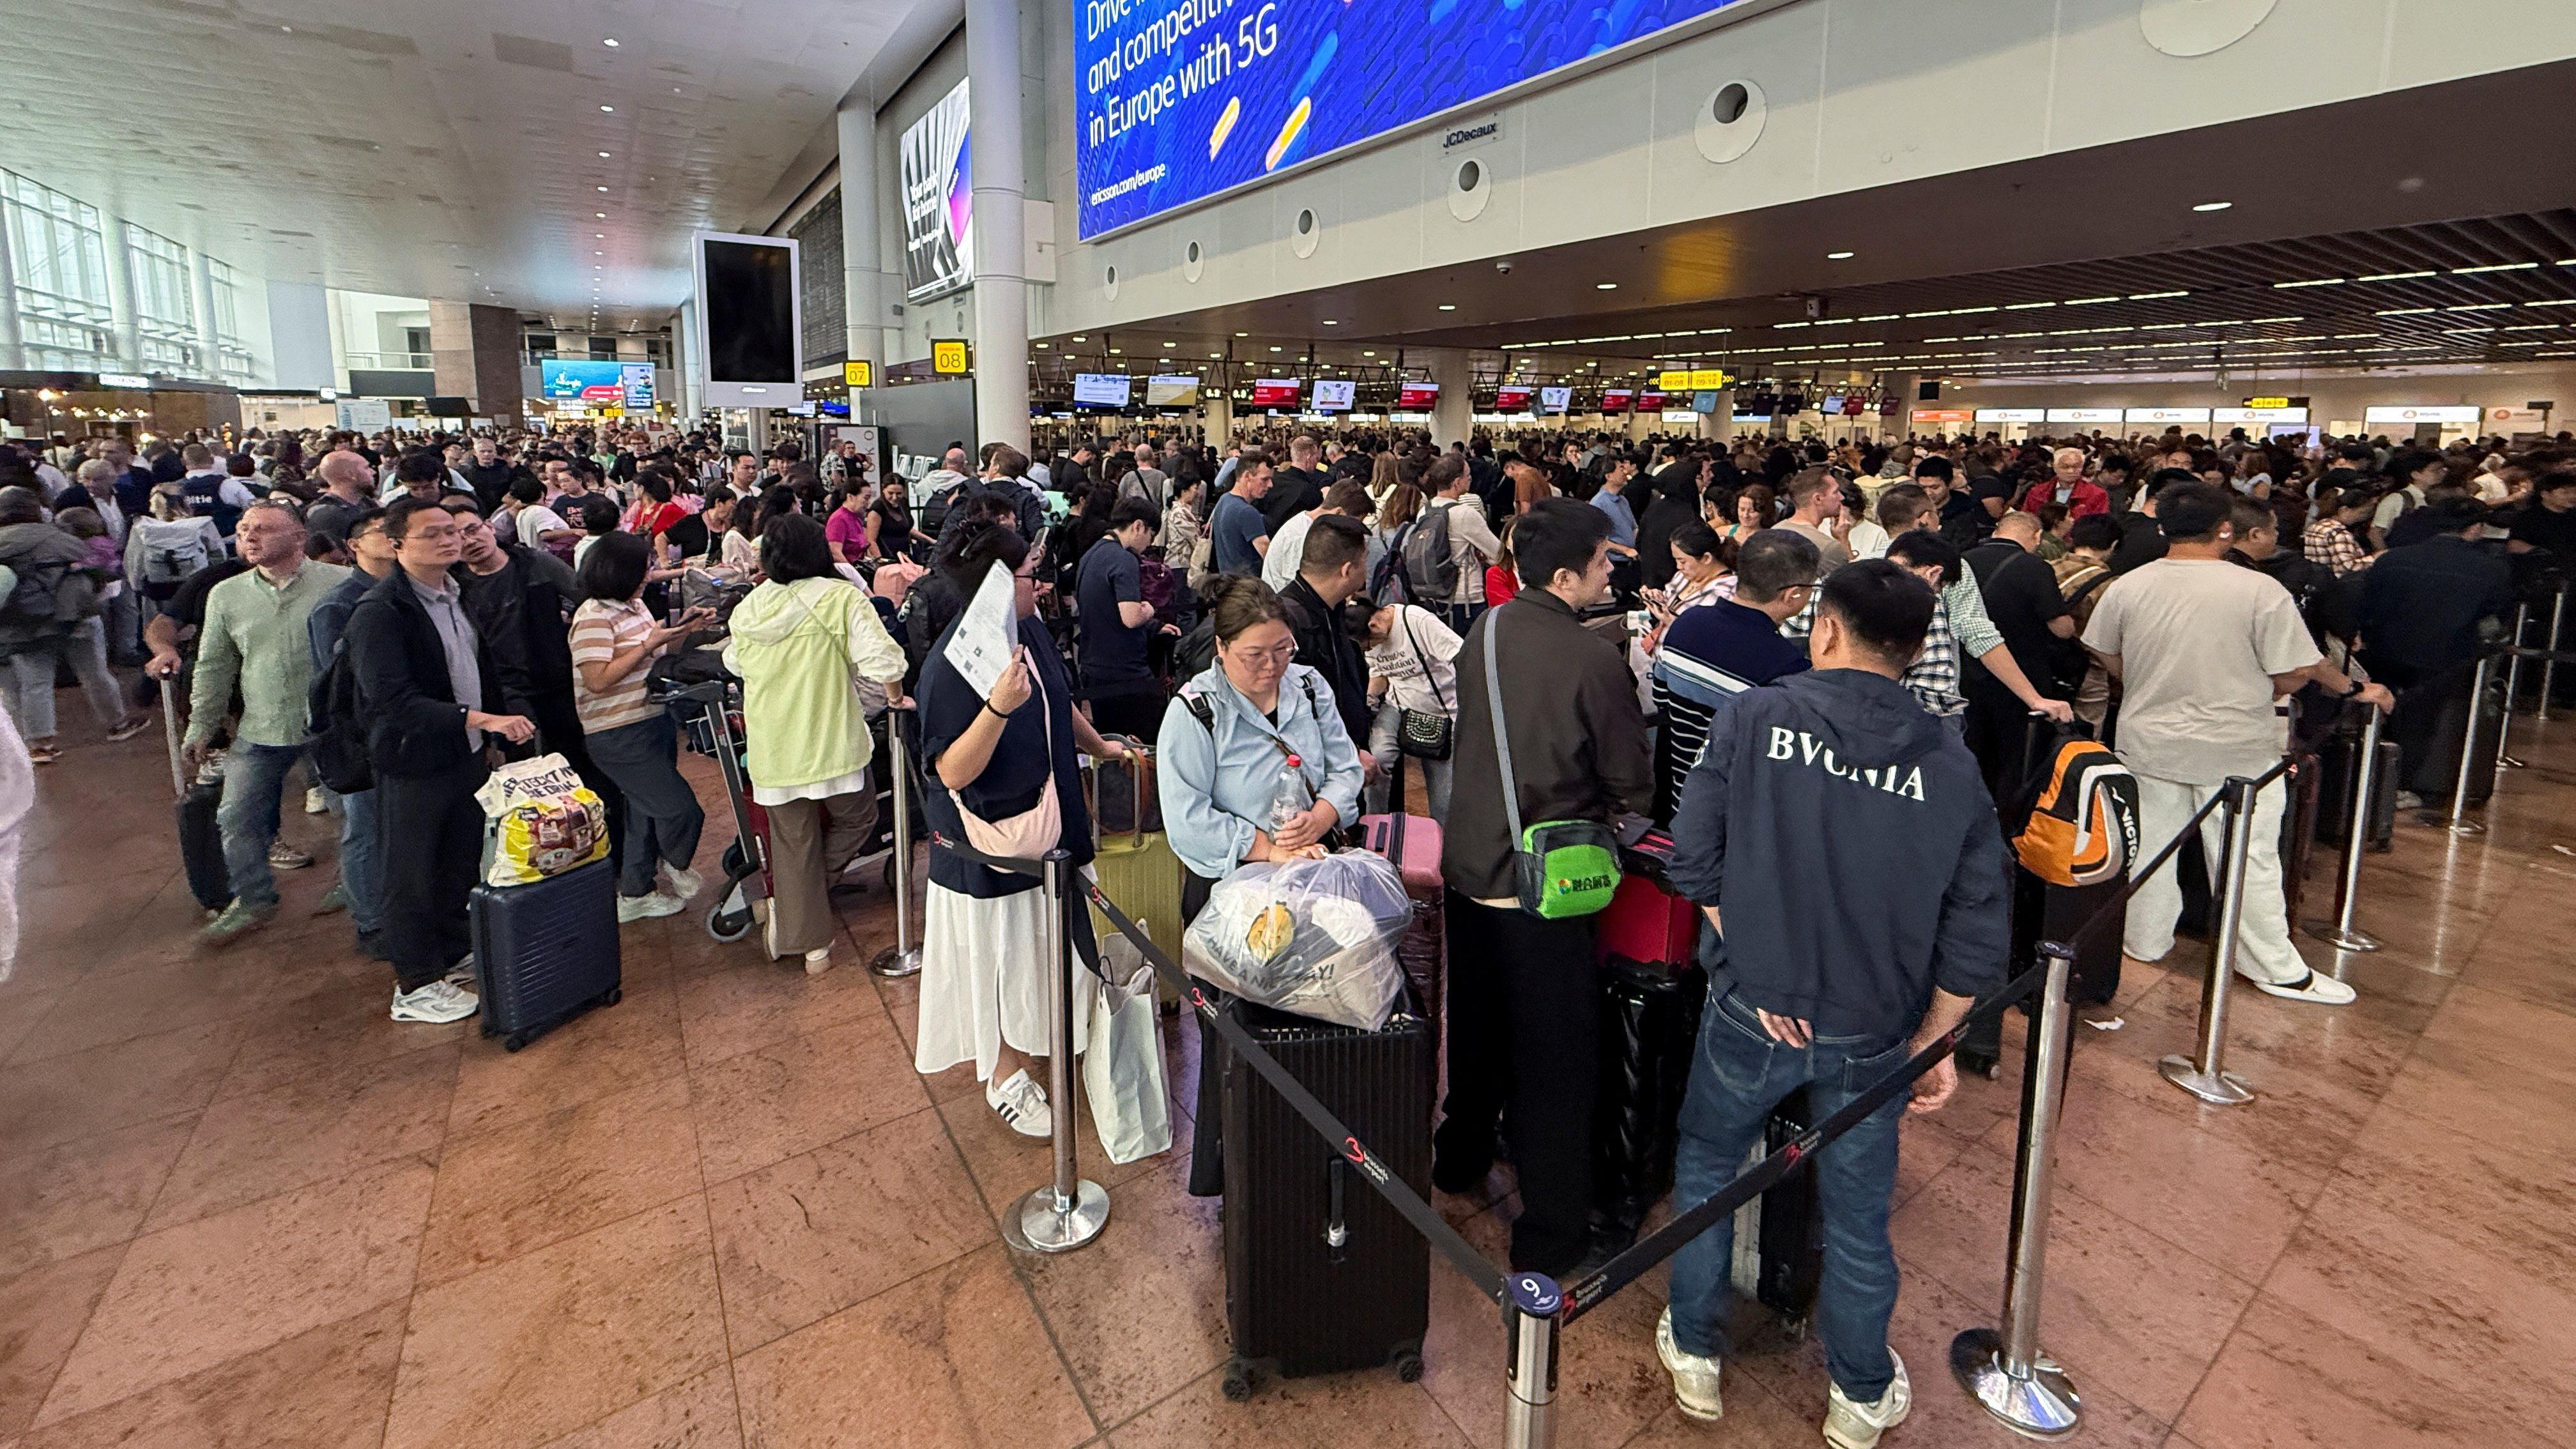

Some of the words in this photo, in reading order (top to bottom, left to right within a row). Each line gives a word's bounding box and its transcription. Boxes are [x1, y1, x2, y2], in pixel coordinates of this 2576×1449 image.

[1088, 0, 1130, 42] Drive
[1089, 37, 1120, 94] and
[1090, 111, 1105, 149] in
[1109, 74, 1175, 139] Europe
[1179, 33, 1230, 98] with
[1238, 3, 1277, 68] 5G
[1443, 123, 1496, 148] JCDecaux
[1091, 163, 1166, 206] ericsson.com/europe
[849, 371, 865, 382] 07
[940, 353, 961, 369] 08
[1522, 1278, 1540, 1298] 9
